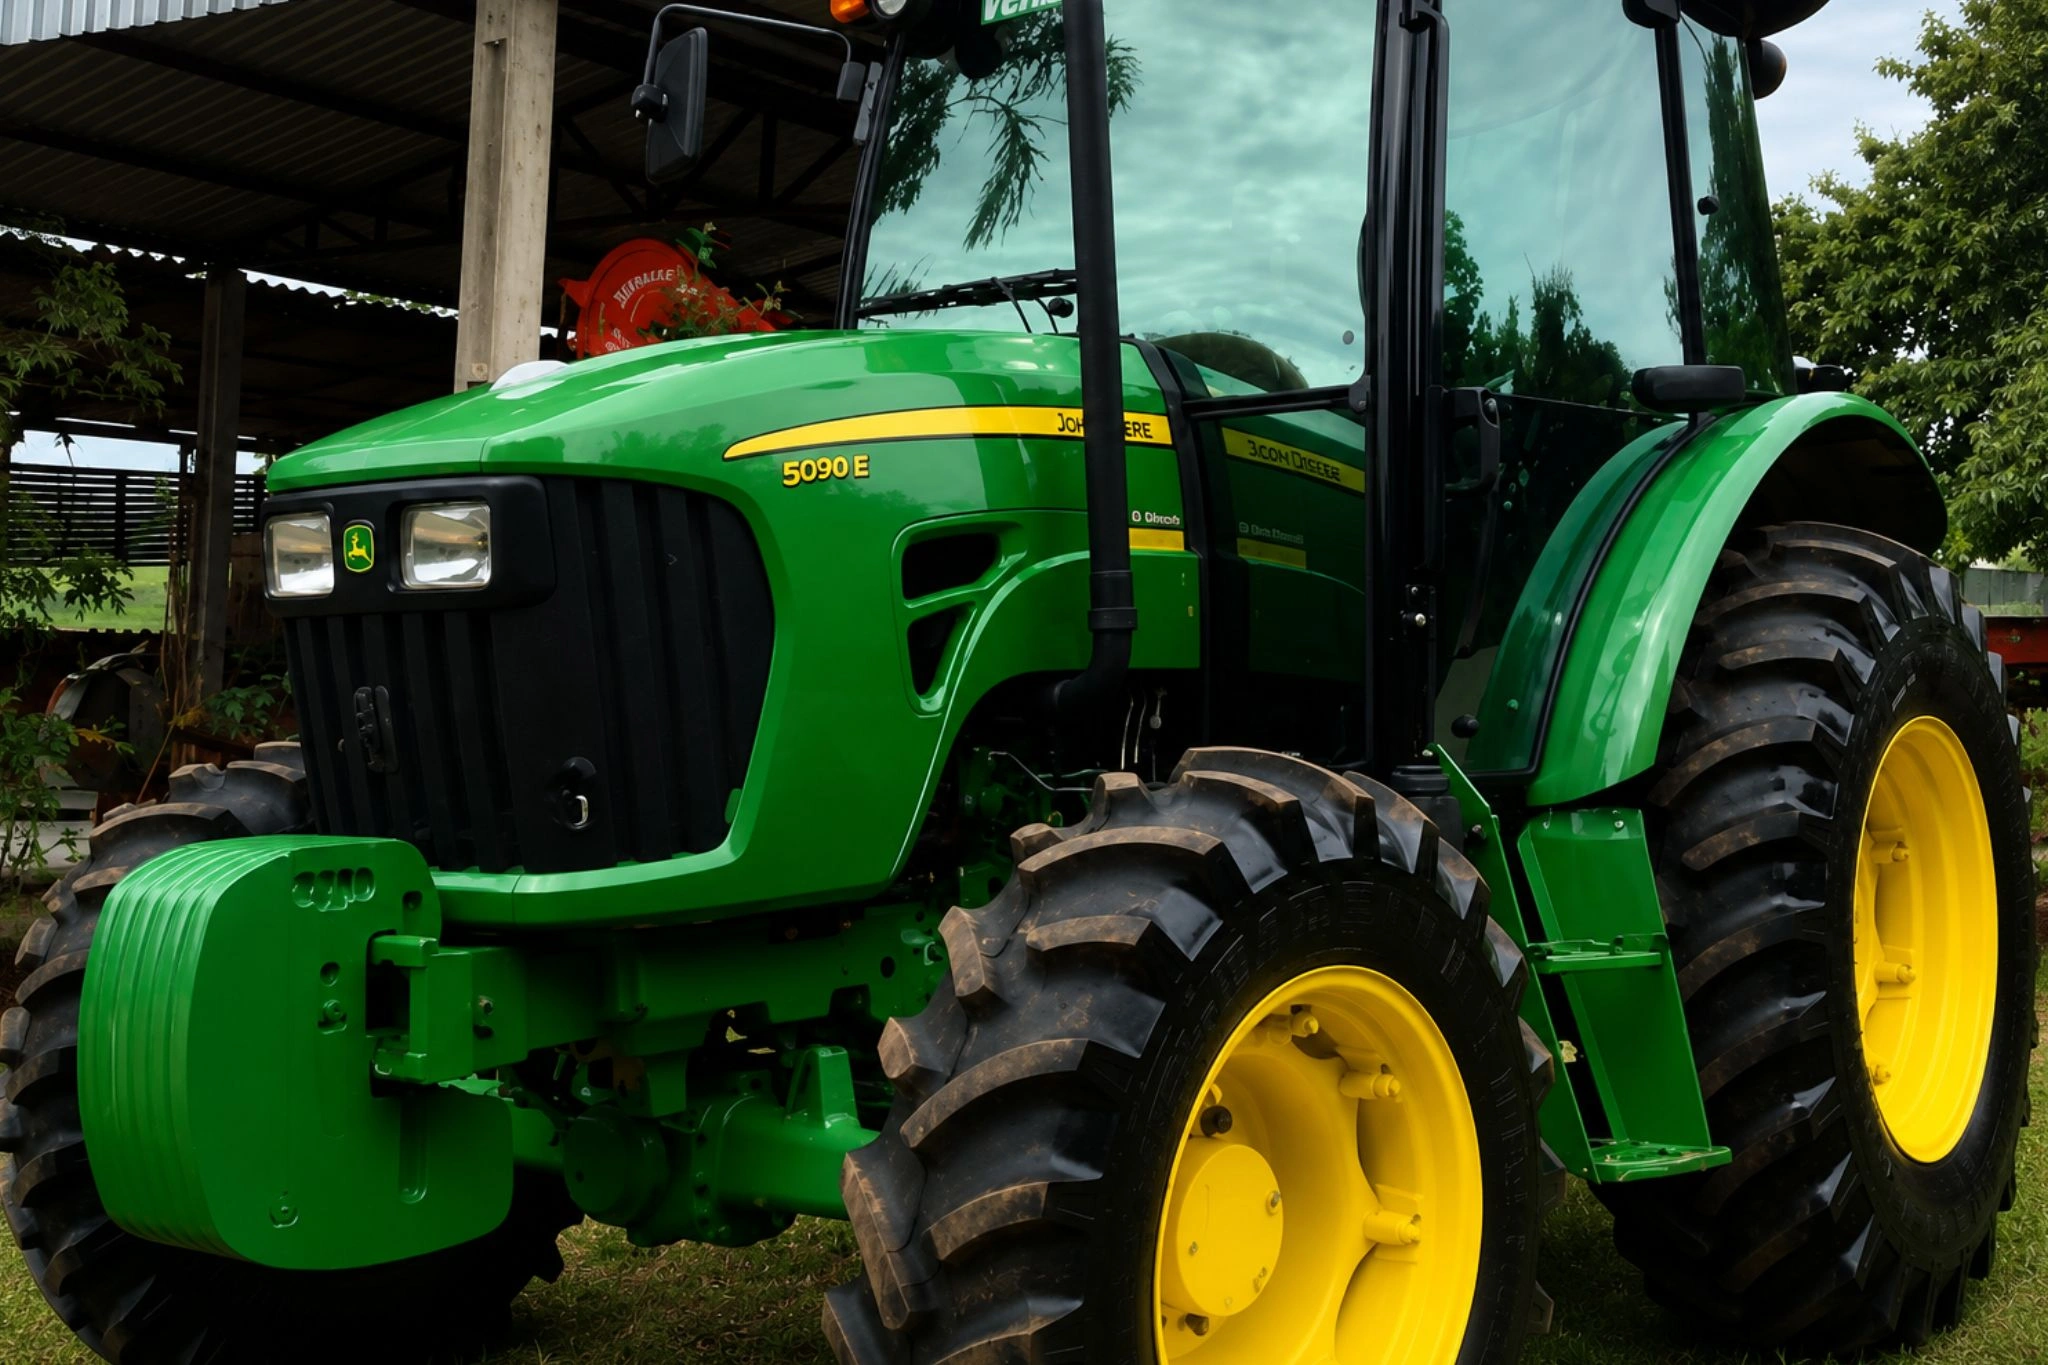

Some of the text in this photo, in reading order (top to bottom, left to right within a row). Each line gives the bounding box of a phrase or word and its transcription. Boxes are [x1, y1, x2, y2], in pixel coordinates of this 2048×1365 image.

[1057, 412, 1153, 439] JOH ERE
[782, 453, 870, 487] 5090 E
